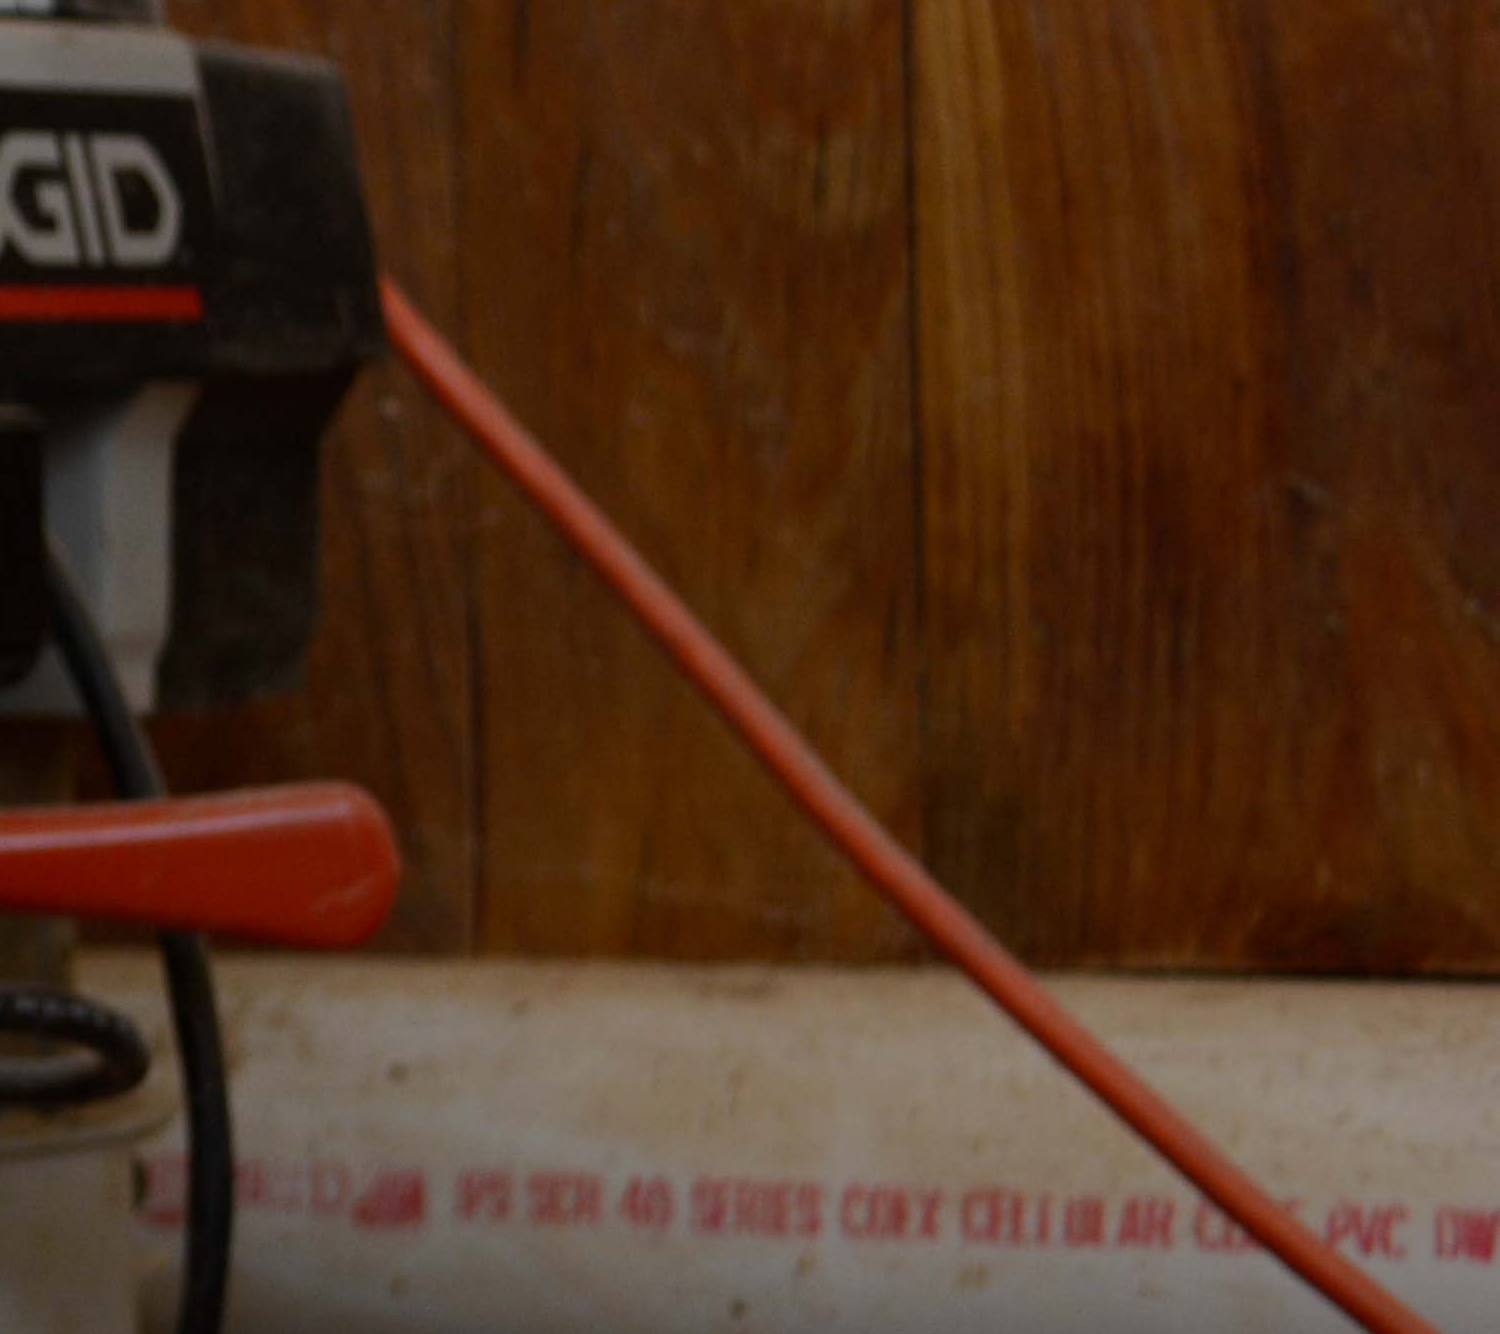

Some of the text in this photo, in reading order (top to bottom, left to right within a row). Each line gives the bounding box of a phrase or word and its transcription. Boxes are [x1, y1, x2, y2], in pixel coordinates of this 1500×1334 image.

[622, 1175, 675, 1229] 40
[691, 1175, 819, 1237] SERIES
[1326, 1201, 1406, 1259] PVC
